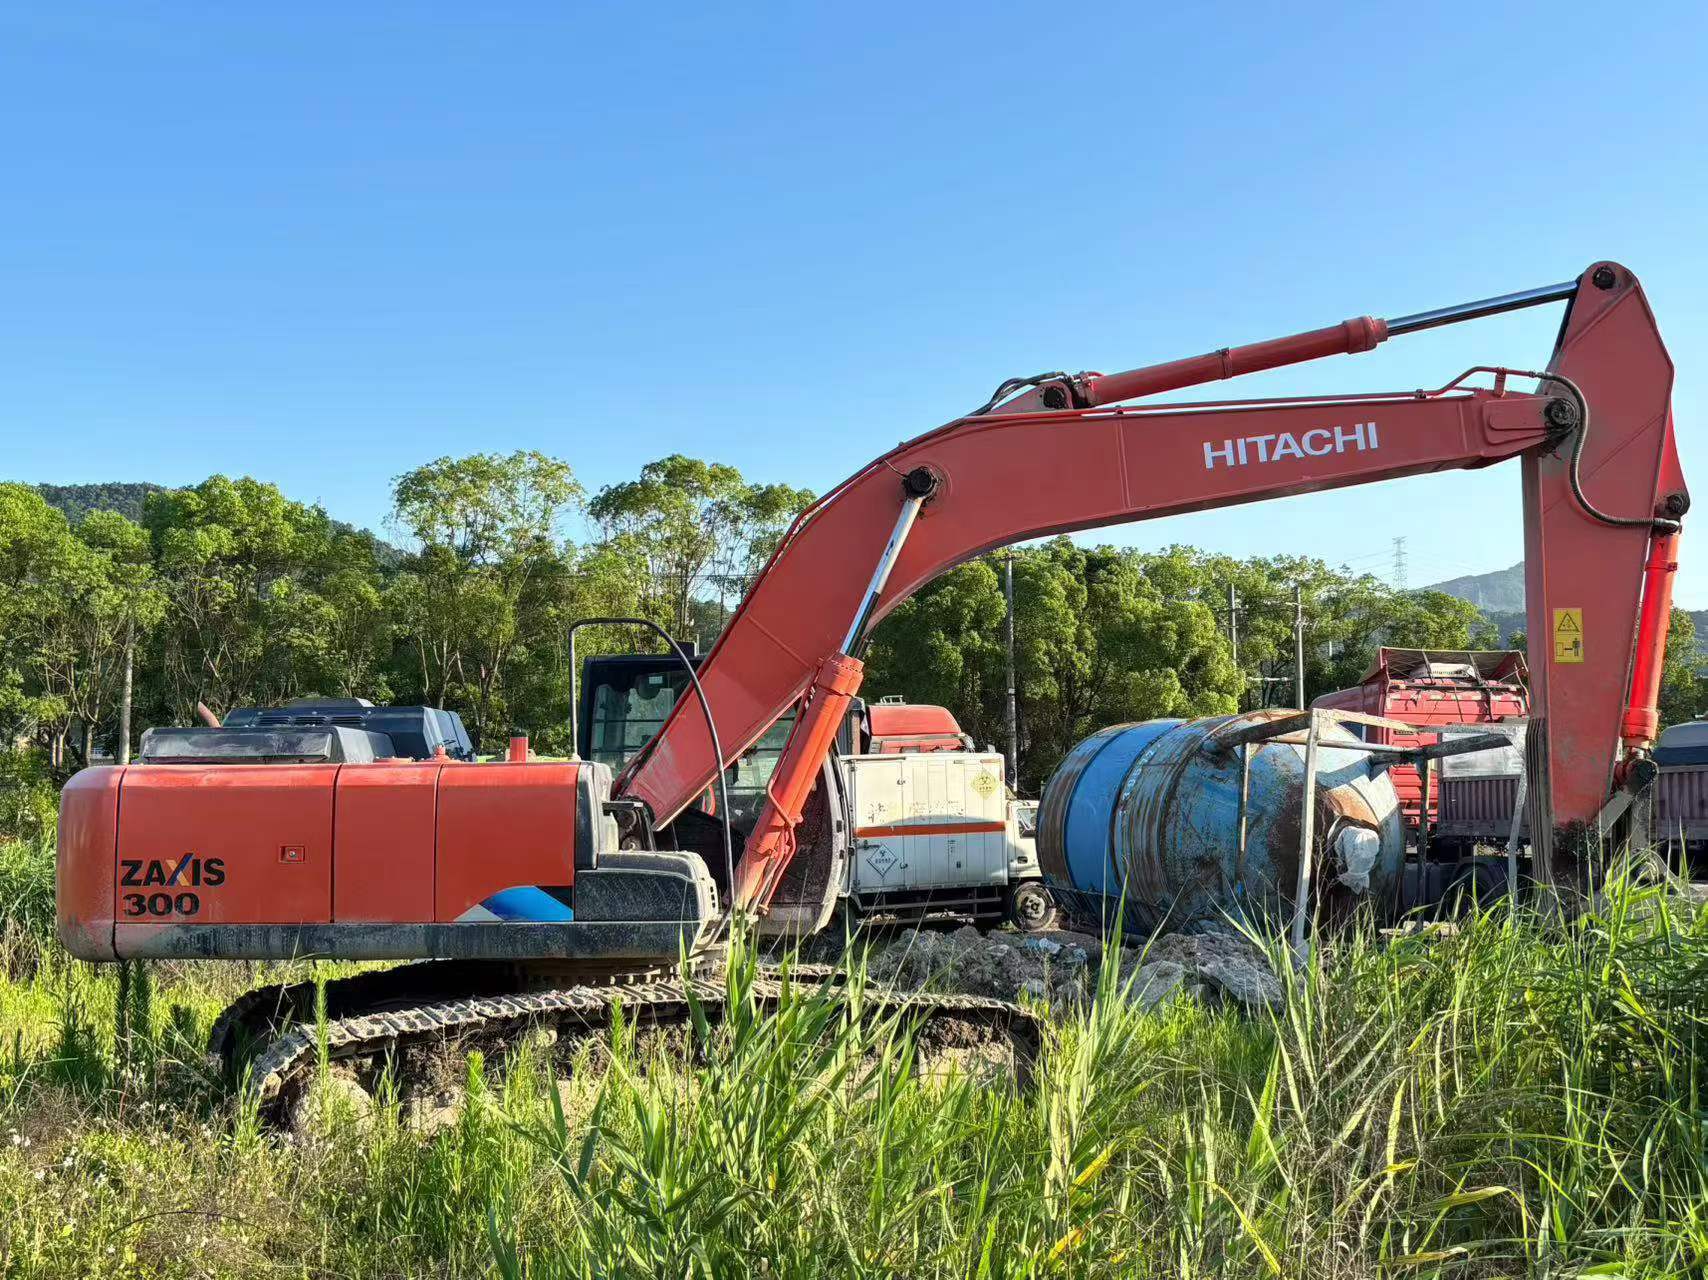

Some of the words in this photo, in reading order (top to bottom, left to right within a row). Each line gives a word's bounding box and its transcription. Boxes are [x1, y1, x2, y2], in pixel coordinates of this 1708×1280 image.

[1203, 422, 1378, 469] HITACHI
[120, 852, 225, 886] ZAXIS
[122, 892, 200, 916] 300
